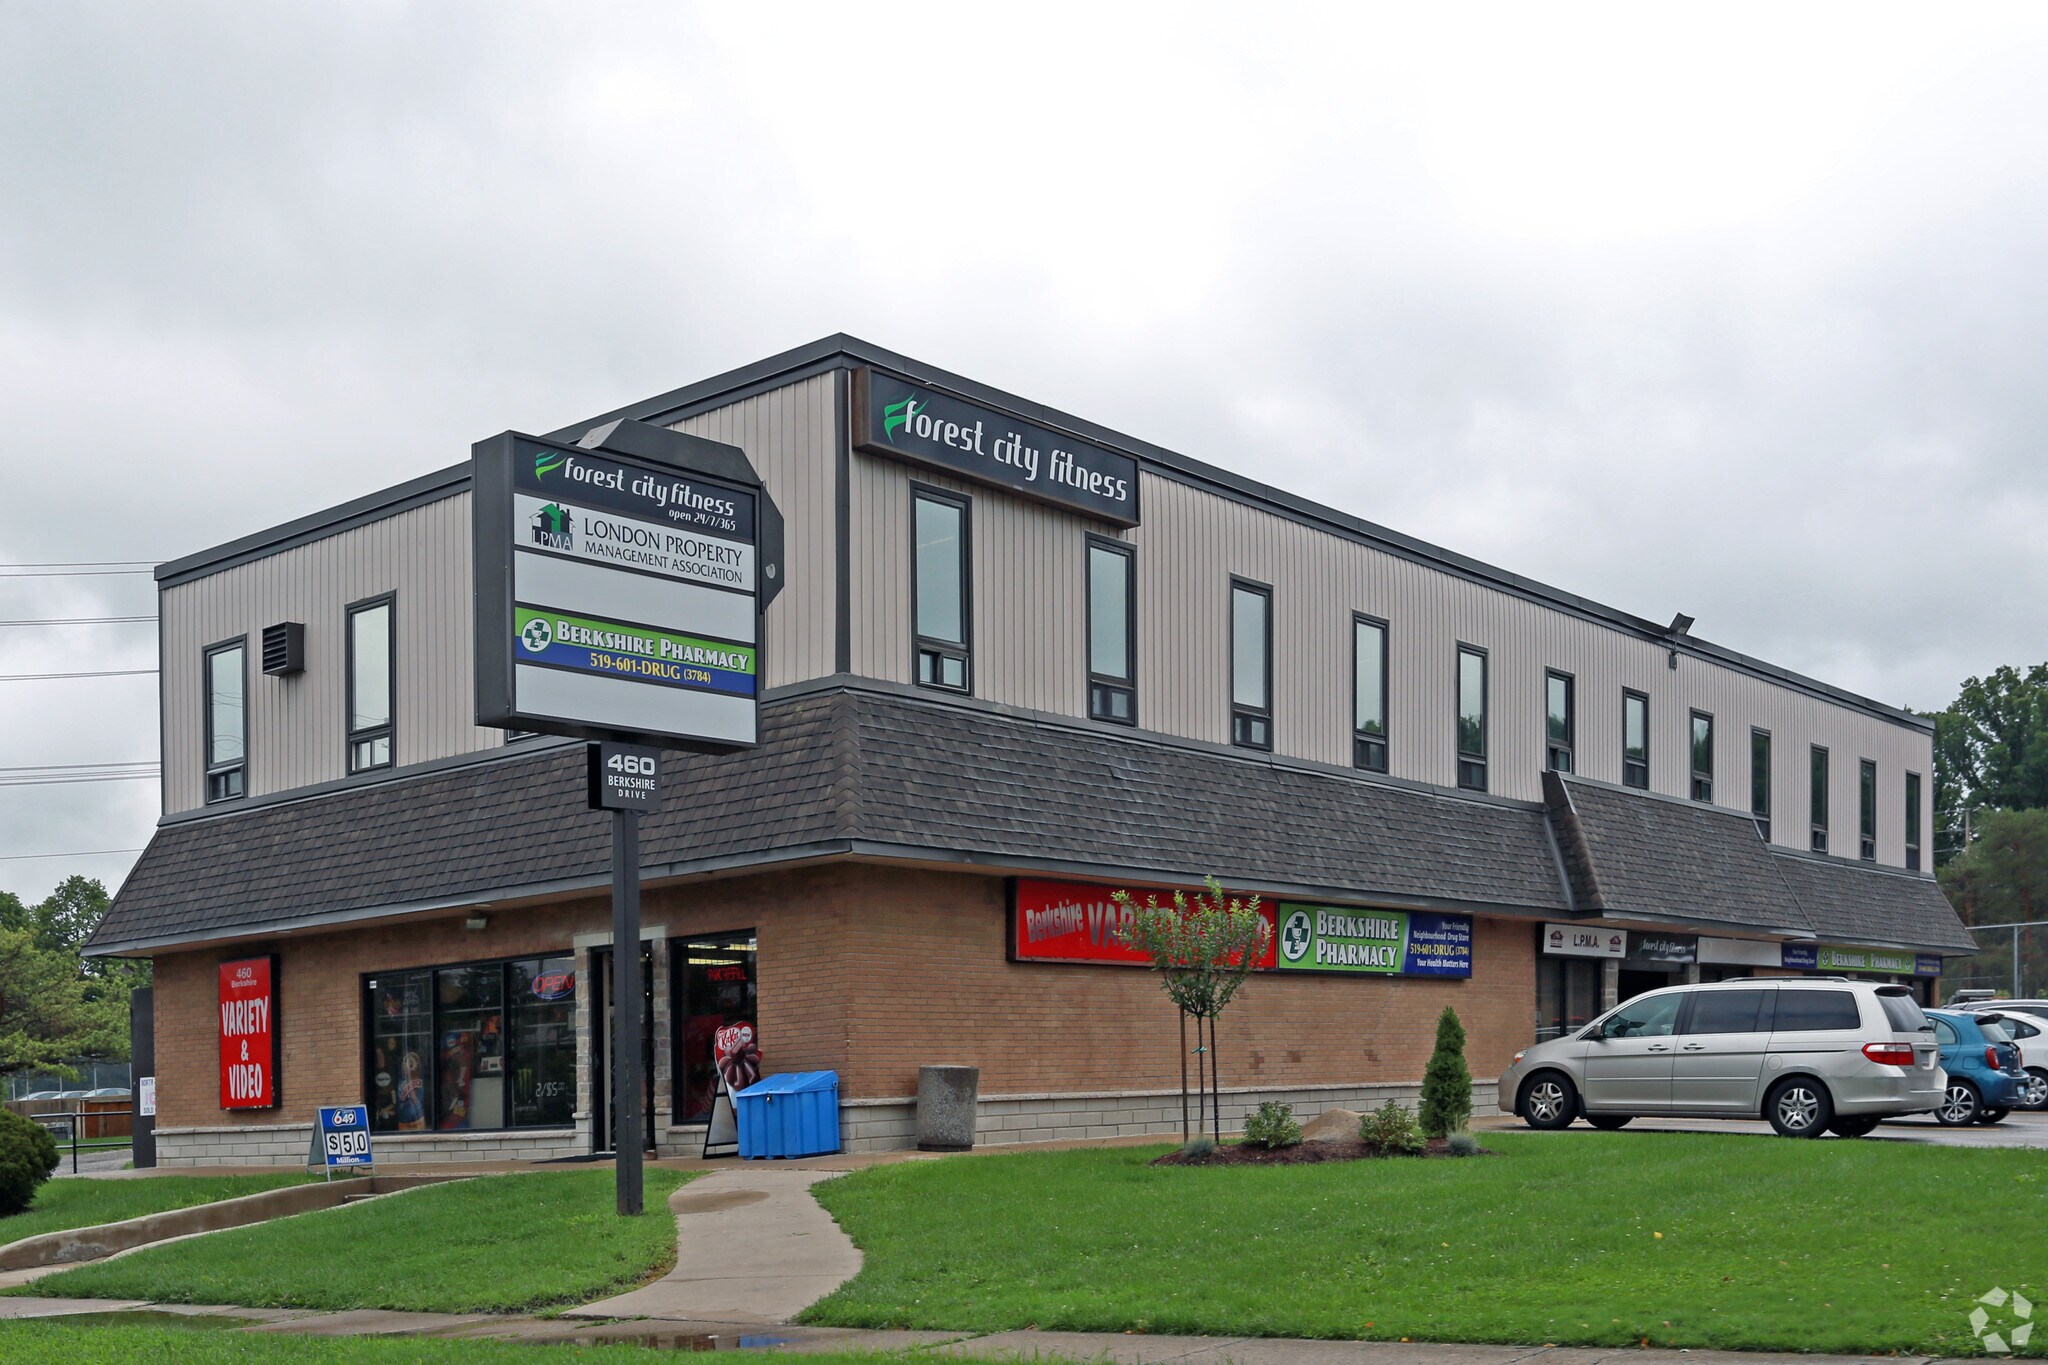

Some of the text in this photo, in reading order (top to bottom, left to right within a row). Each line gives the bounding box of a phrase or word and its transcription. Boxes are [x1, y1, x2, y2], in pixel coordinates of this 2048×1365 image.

[904, 399, 1127, 502] forest city fitness
[564, 457, 735, 517] forest city fitness
[668, 509, 736, 531] open 24/7/365
[532, 529, 573, 551] LPMA
[584, 517, 743, 567] LONDON PROPERTY
[584, 541, 743, 584] MANAGEMENT ASSOCIATION
[556, 620, 749, 672] BERKSHIRE PHARMACY
[589, 652, 711, 685] 519-601-DRUG (3784)
[607, 753, 656, 776] 460
[607, 774, 656, 791] BERKSHIRE
[617, 788, 647, 801] DRIVE
[1025, 898, 1085, 944] Berkshire
[1316, 910, 1399, 940] BERKSHIRE
[1413, 930, 1469, 943] Neighbourhood Drug Store
[1316, 939, 1397, 967] PHARMACY
[1410, 943, 1454, 956] 519-601-DRUG
[1832, 951, 1866, 967] BERKSHIRE
[1871, 953, 1903, 970] PHARMACY
[231, 979, 257, 988] Berkshire
[236, 967, 252, 979] 460
[533, 974, 575, 992] OPEN
[221, 995, 269, 1037] VARIETY
[240, 1039, 249, 1061] &
[228, 1063, 262, 1100] VIDEO
